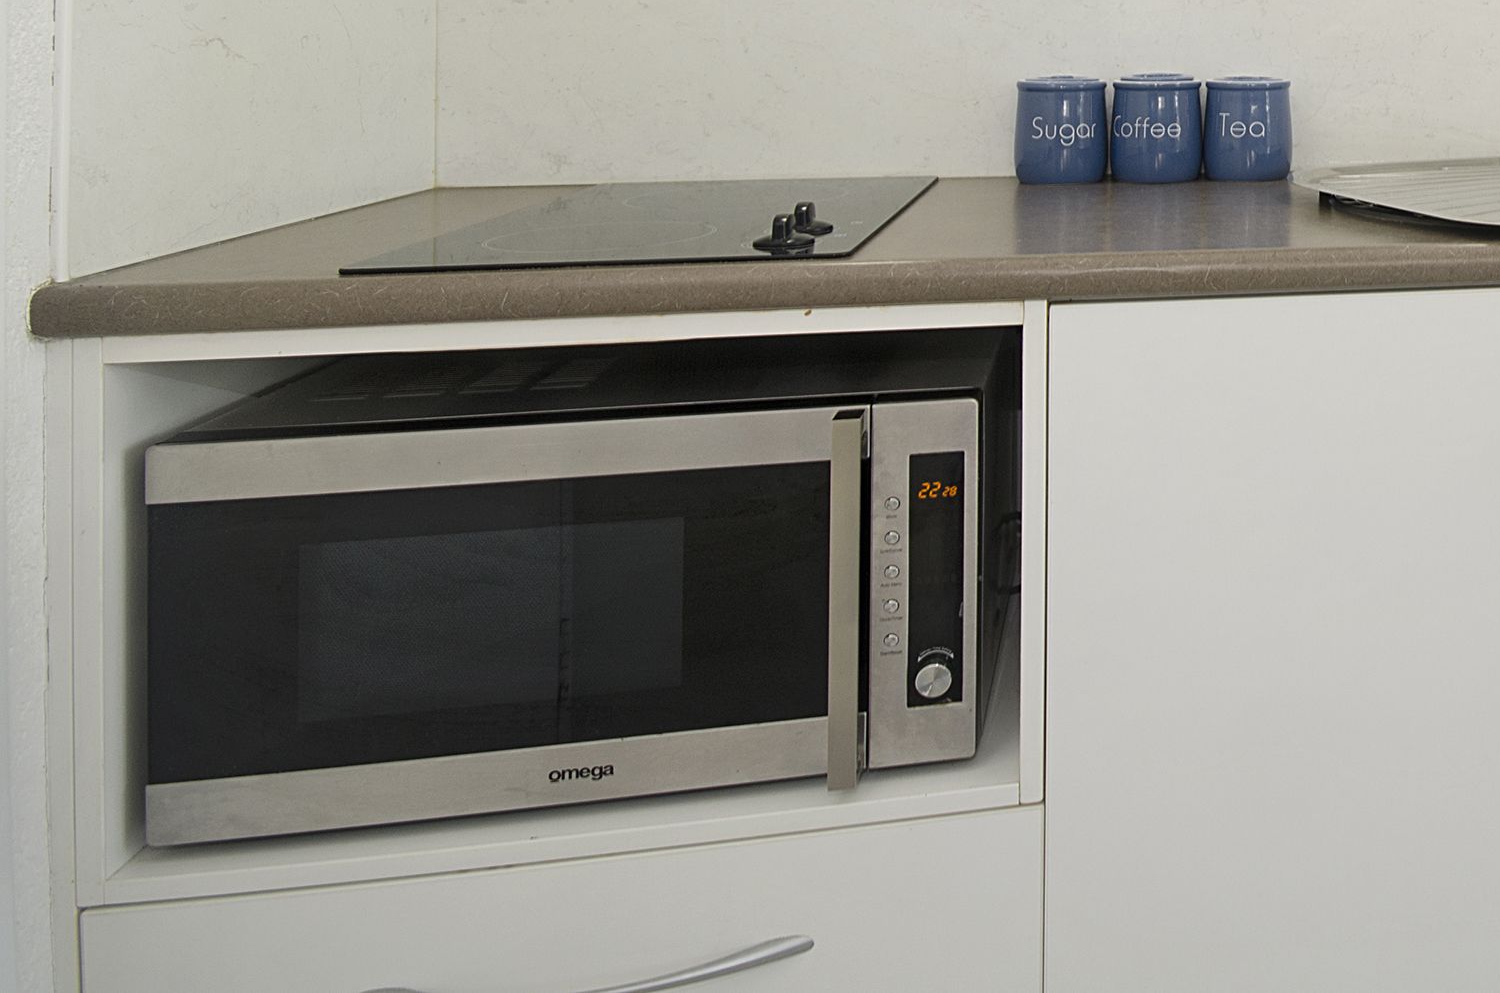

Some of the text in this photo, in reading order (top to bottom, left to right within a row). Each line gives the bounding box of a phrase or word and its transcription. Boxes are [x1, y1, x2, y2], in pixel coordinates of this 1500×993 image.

[1032, 116, 1096, 146] Sugar
[1113, 115, 1181, 139] Coffee
[1219, 113, 1265, 138] Tea
[548, 764, 614, 782] omega
